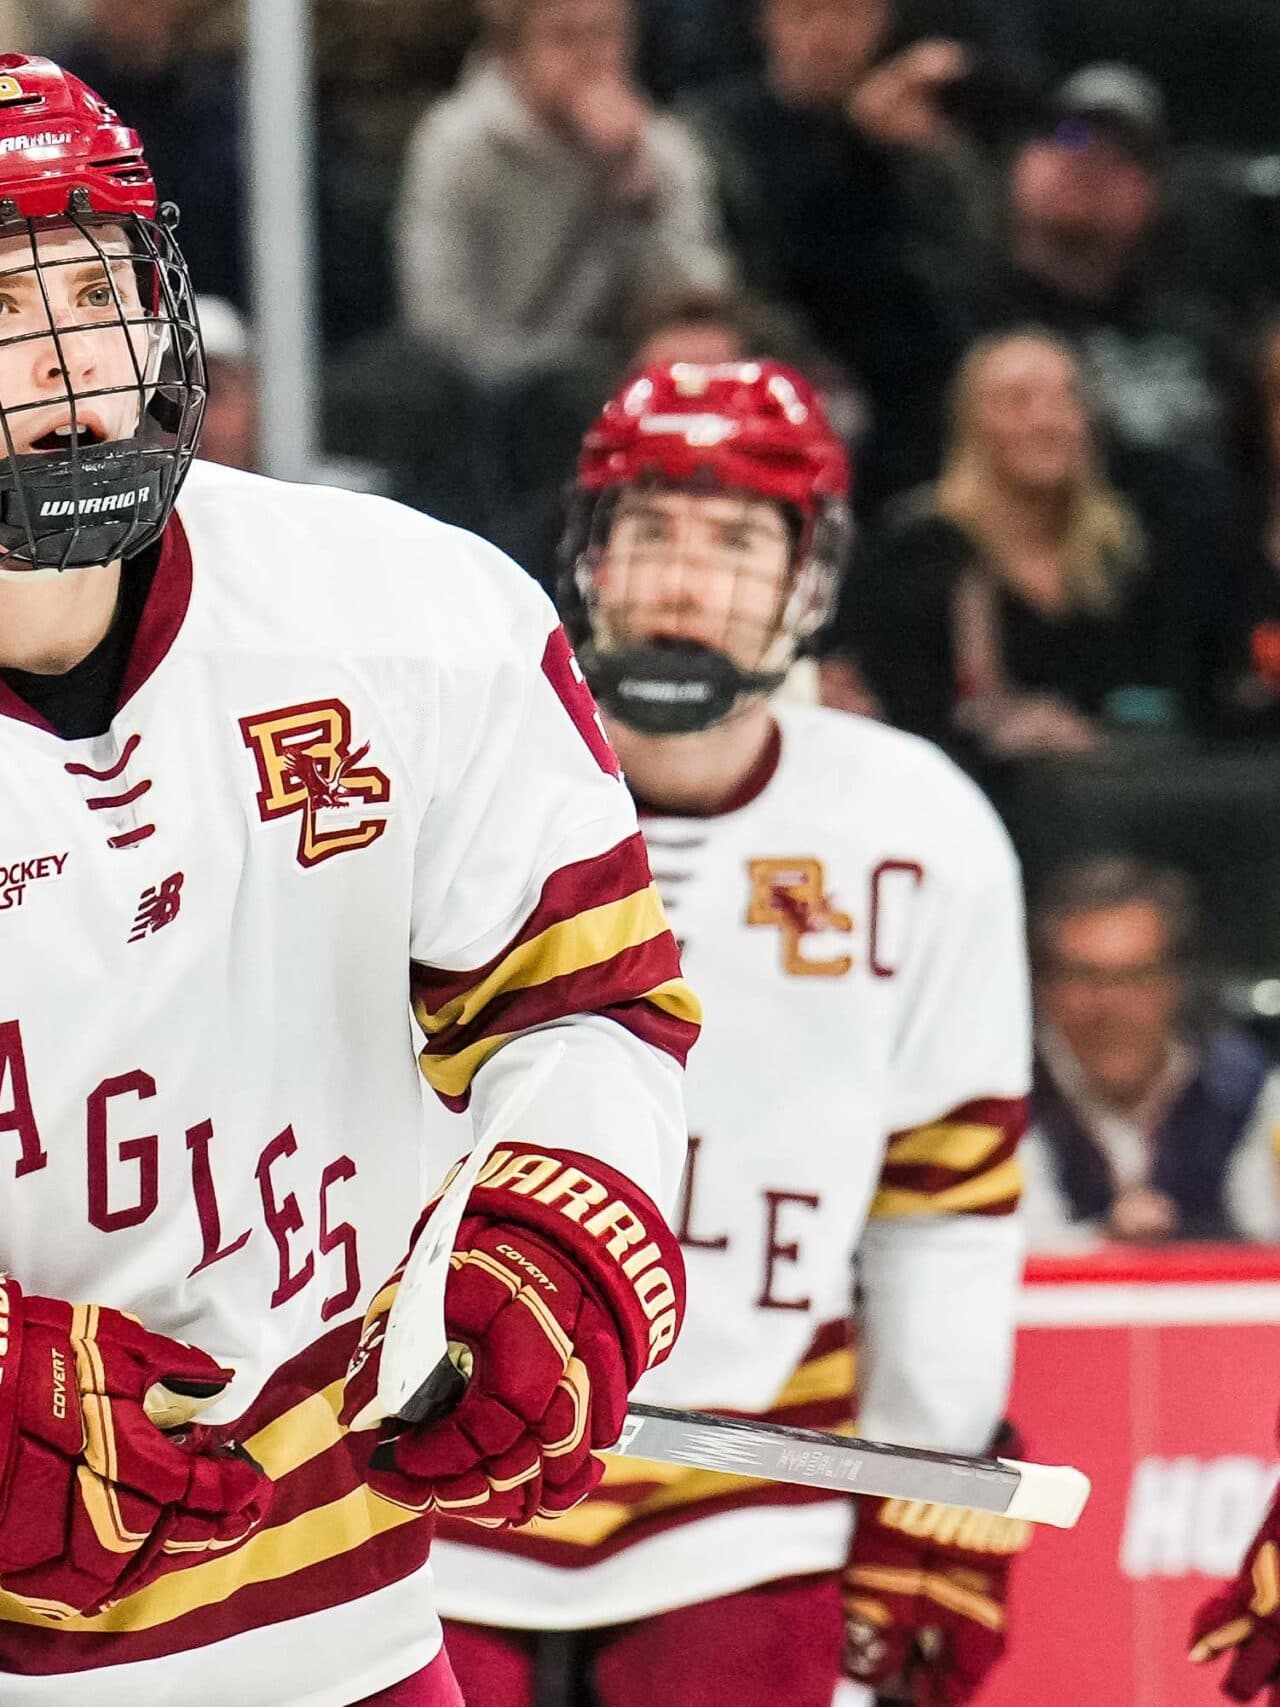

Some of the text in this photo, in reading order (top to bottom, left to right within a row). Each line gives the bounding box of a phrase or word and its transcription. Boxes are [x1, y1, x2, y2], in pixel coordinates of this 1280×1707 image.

[39, 486, 151, 517] WARRIOR
[495, 1243, 560, 1293] COVERT
[52, 1347, 67, 1420] COVERT
